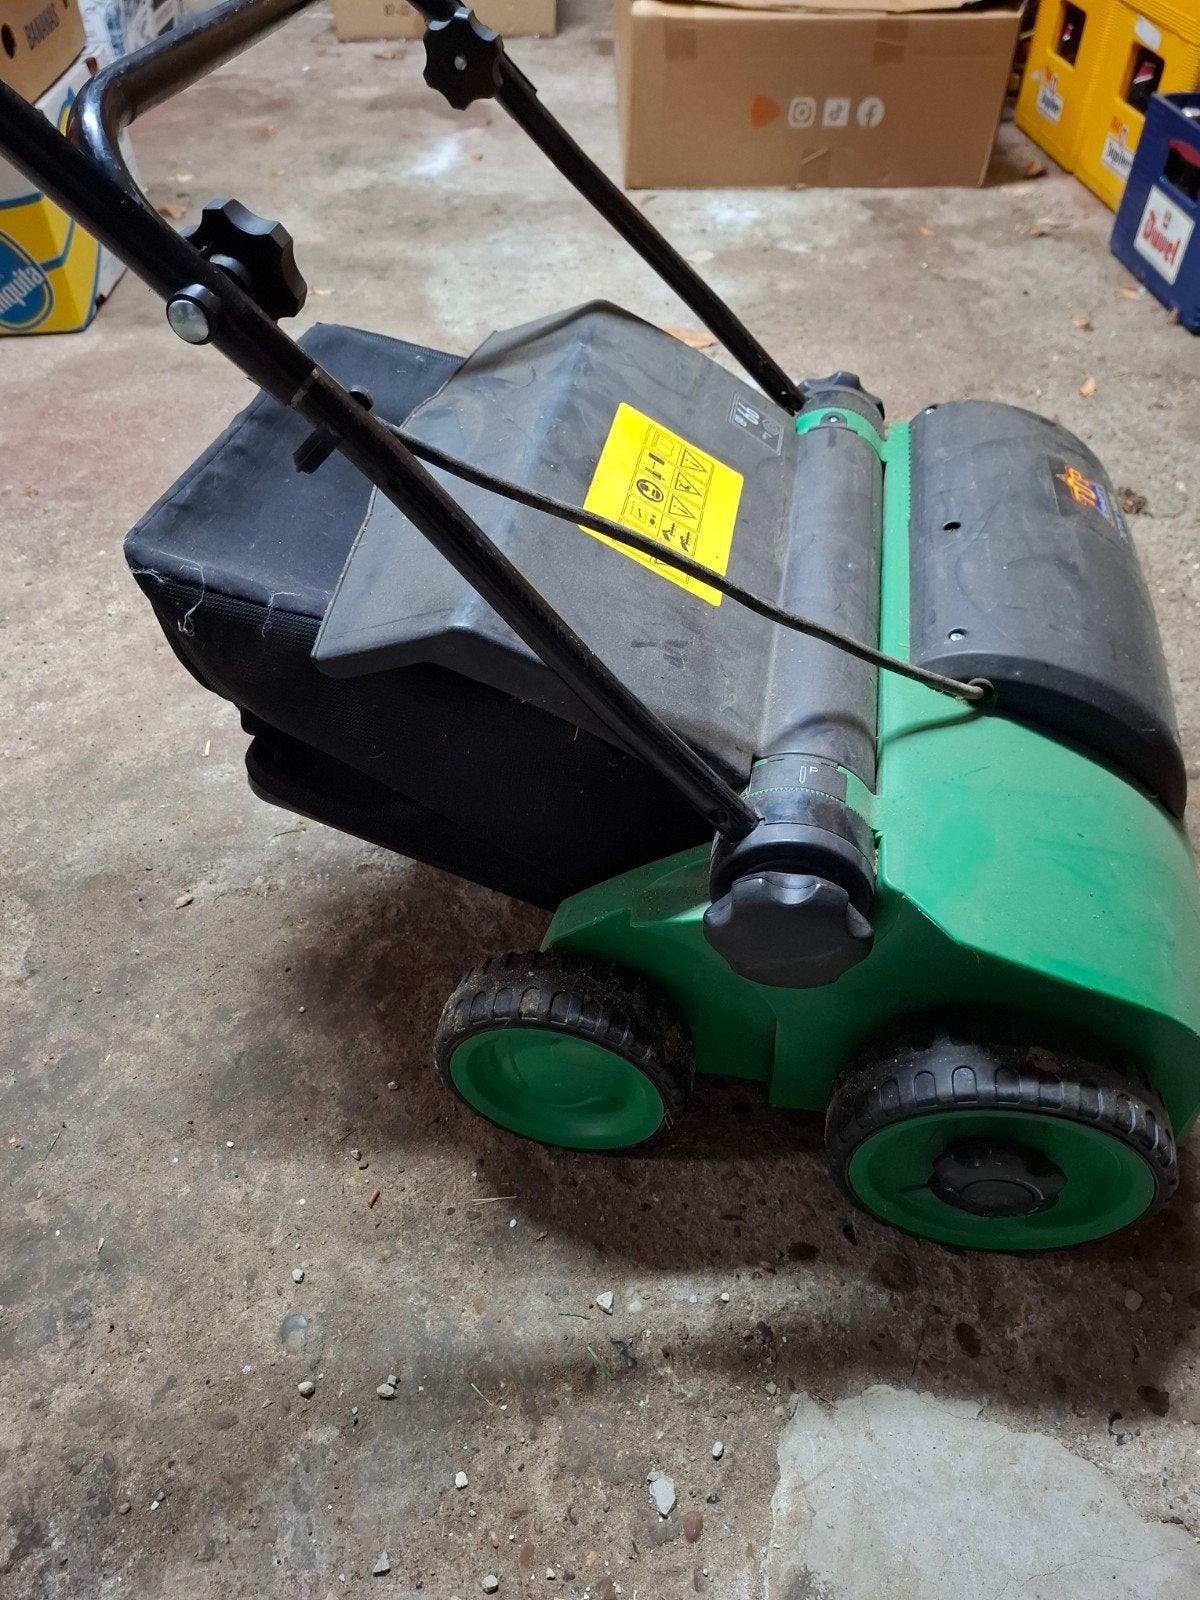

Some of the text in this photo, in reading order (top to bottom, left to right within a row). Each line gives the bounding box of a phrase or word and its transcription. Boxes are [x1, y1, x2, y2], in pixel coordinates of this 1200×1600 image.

[1143, 208, 1181, 267] Duvel
[0, 263, 44, 314] iquita
[737, 401, 760, 425] 99
[809, 766, 819, 774] P
